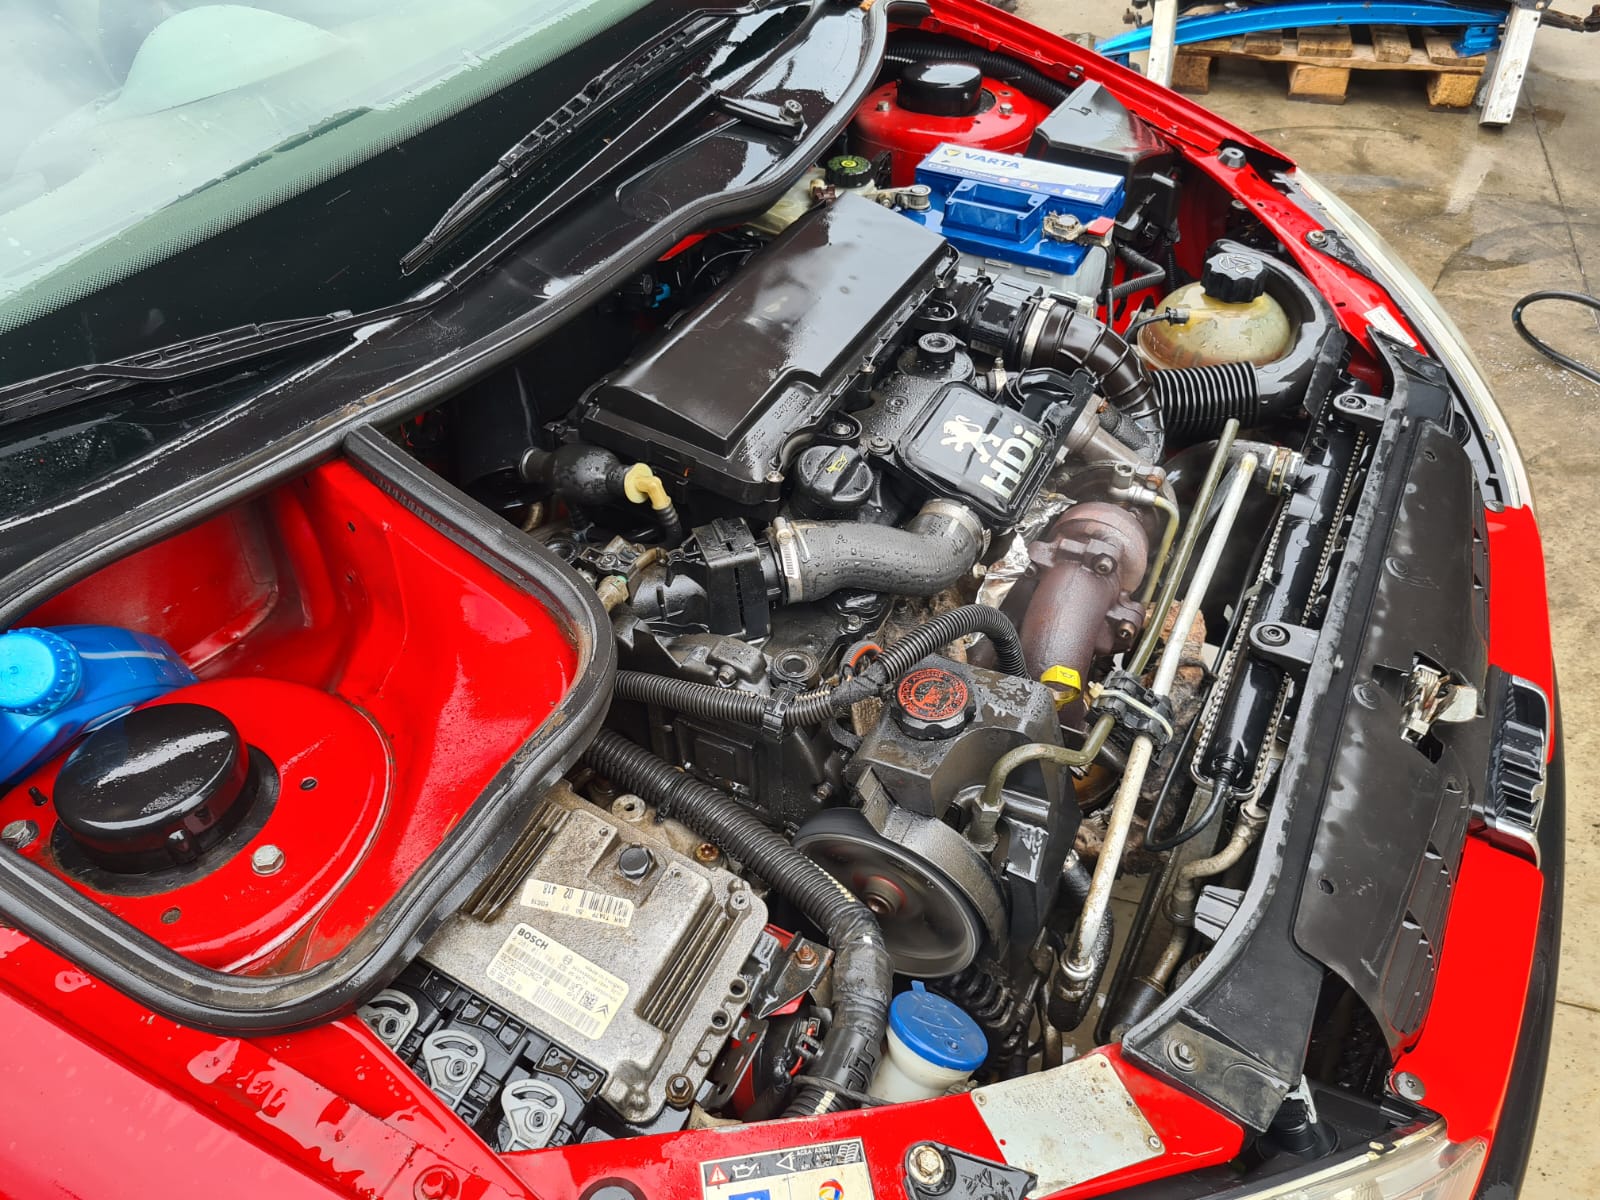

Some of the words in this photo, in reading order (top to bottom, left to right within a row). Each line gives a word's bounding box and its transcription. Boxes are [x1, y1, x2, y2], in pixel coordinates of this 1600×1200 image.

[964, 153, 1020, 169] VARTA
[979, 425, 1043, 499] HDi
[516, 928, 549, 951] BOSCH
